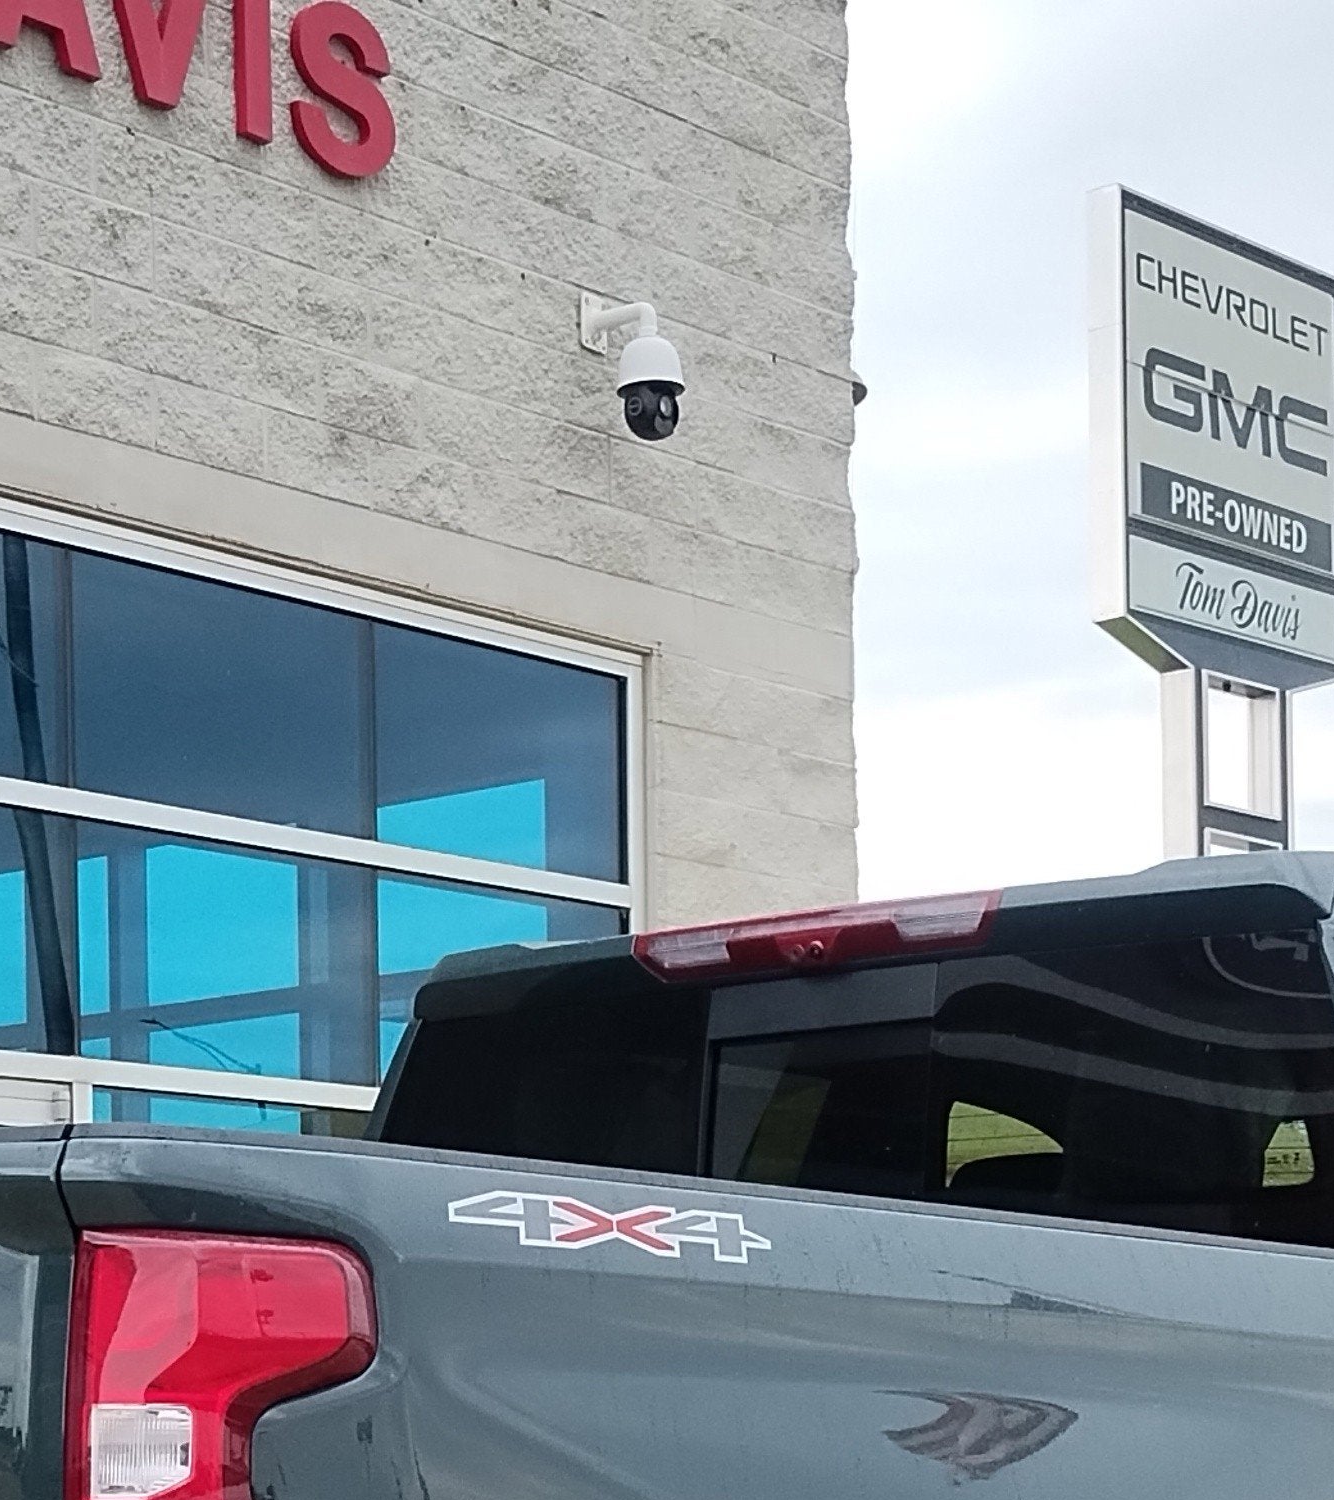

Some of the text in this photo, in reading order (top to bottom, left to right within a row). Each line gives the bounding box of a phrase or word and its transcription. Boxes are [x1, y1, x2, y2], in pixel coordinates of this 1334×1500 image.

[1136, 252, 1328, 356] CHEVROLET
[1143, 347, 1328, 477] GMC
[1170, 481, 1308, 554] PRE-OWNED
[1175, 562, 1300, 640] Tom Davis
